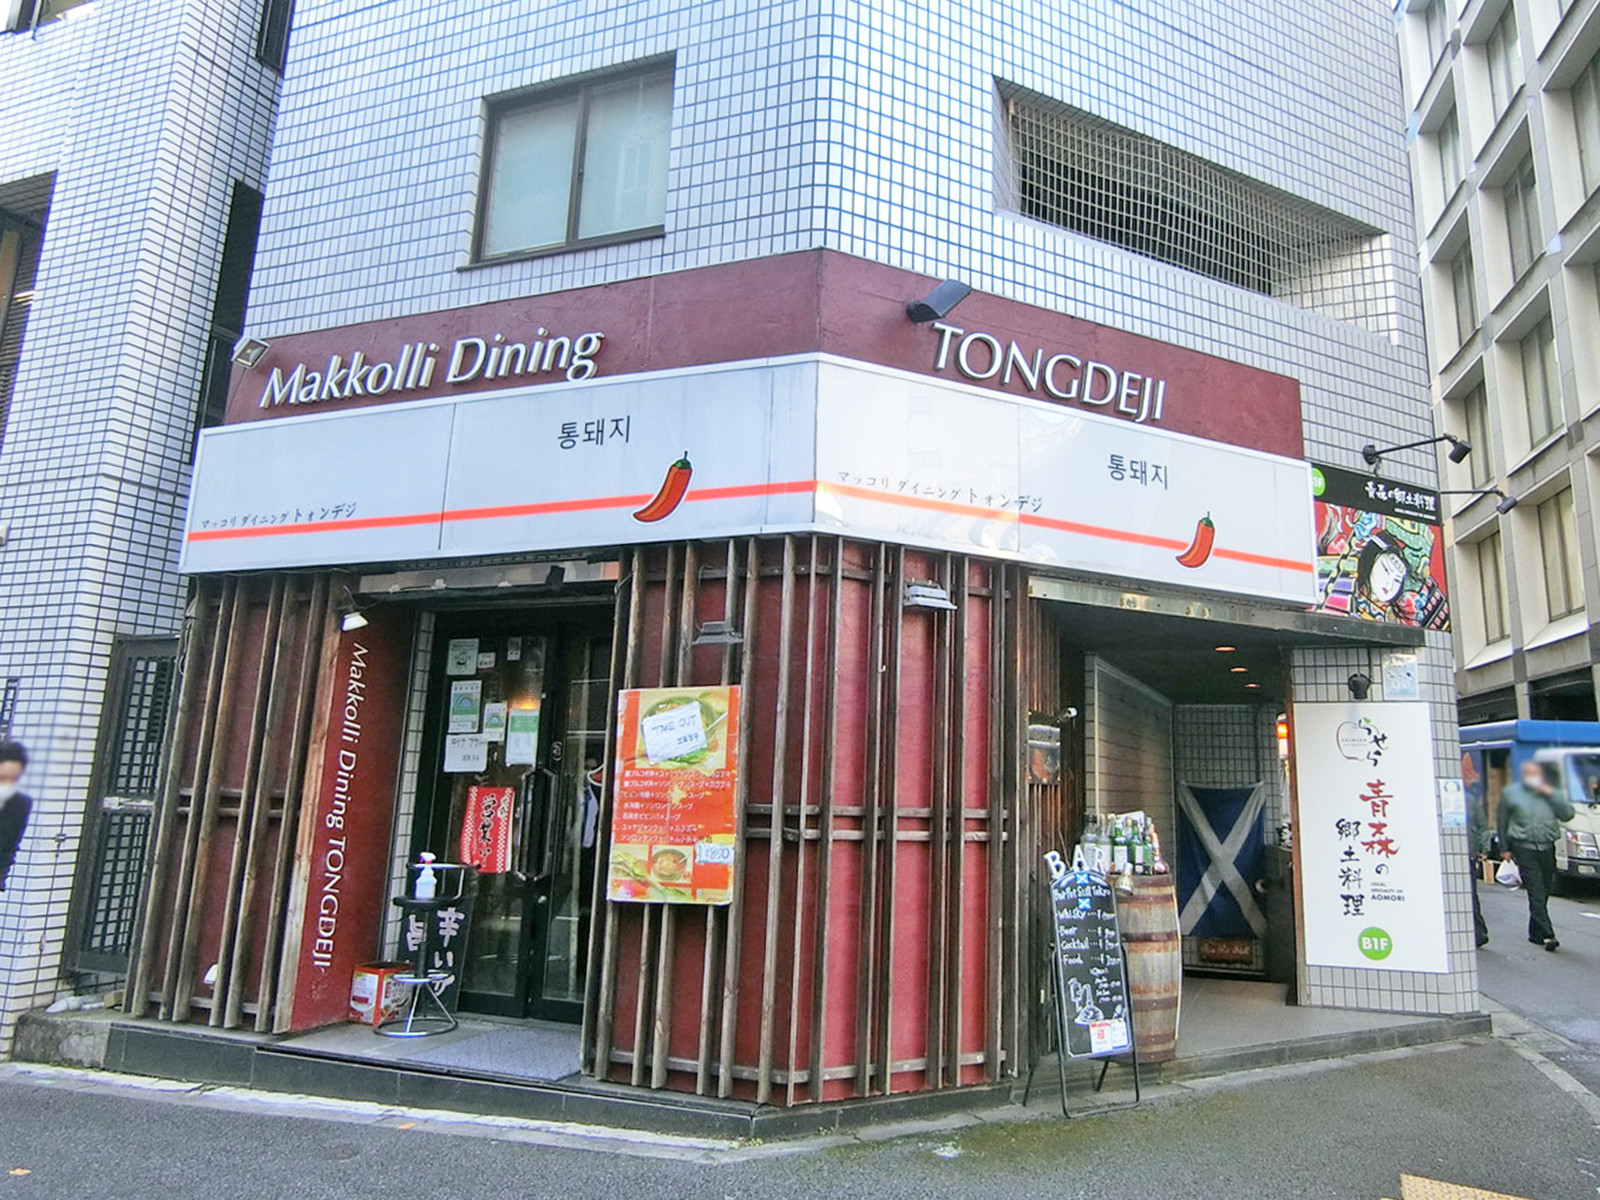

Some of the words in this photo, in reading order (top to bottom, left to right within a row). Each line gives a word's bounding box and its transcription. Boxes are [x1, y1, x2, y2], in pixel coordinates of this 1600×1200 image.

[259, 342, 440, 409] Makkolli
[446, 327, 605, 383] Dining
[931, 321, 1166, 423] TONGDEJI
[557, 415, 631, 450] 통돼지
[1107, 453, 1169, 490] 통돼지
[342, 642, 369, 744] Makkolli
[325, 749, 357, 830] Dining
[1043, 844, 1107, 880] BAR
[313, 836, 347, 968] TONGDEJI
[1371, 893, 1406, 902] AOMORI
[1362, 936, 1389, 951] B1F
